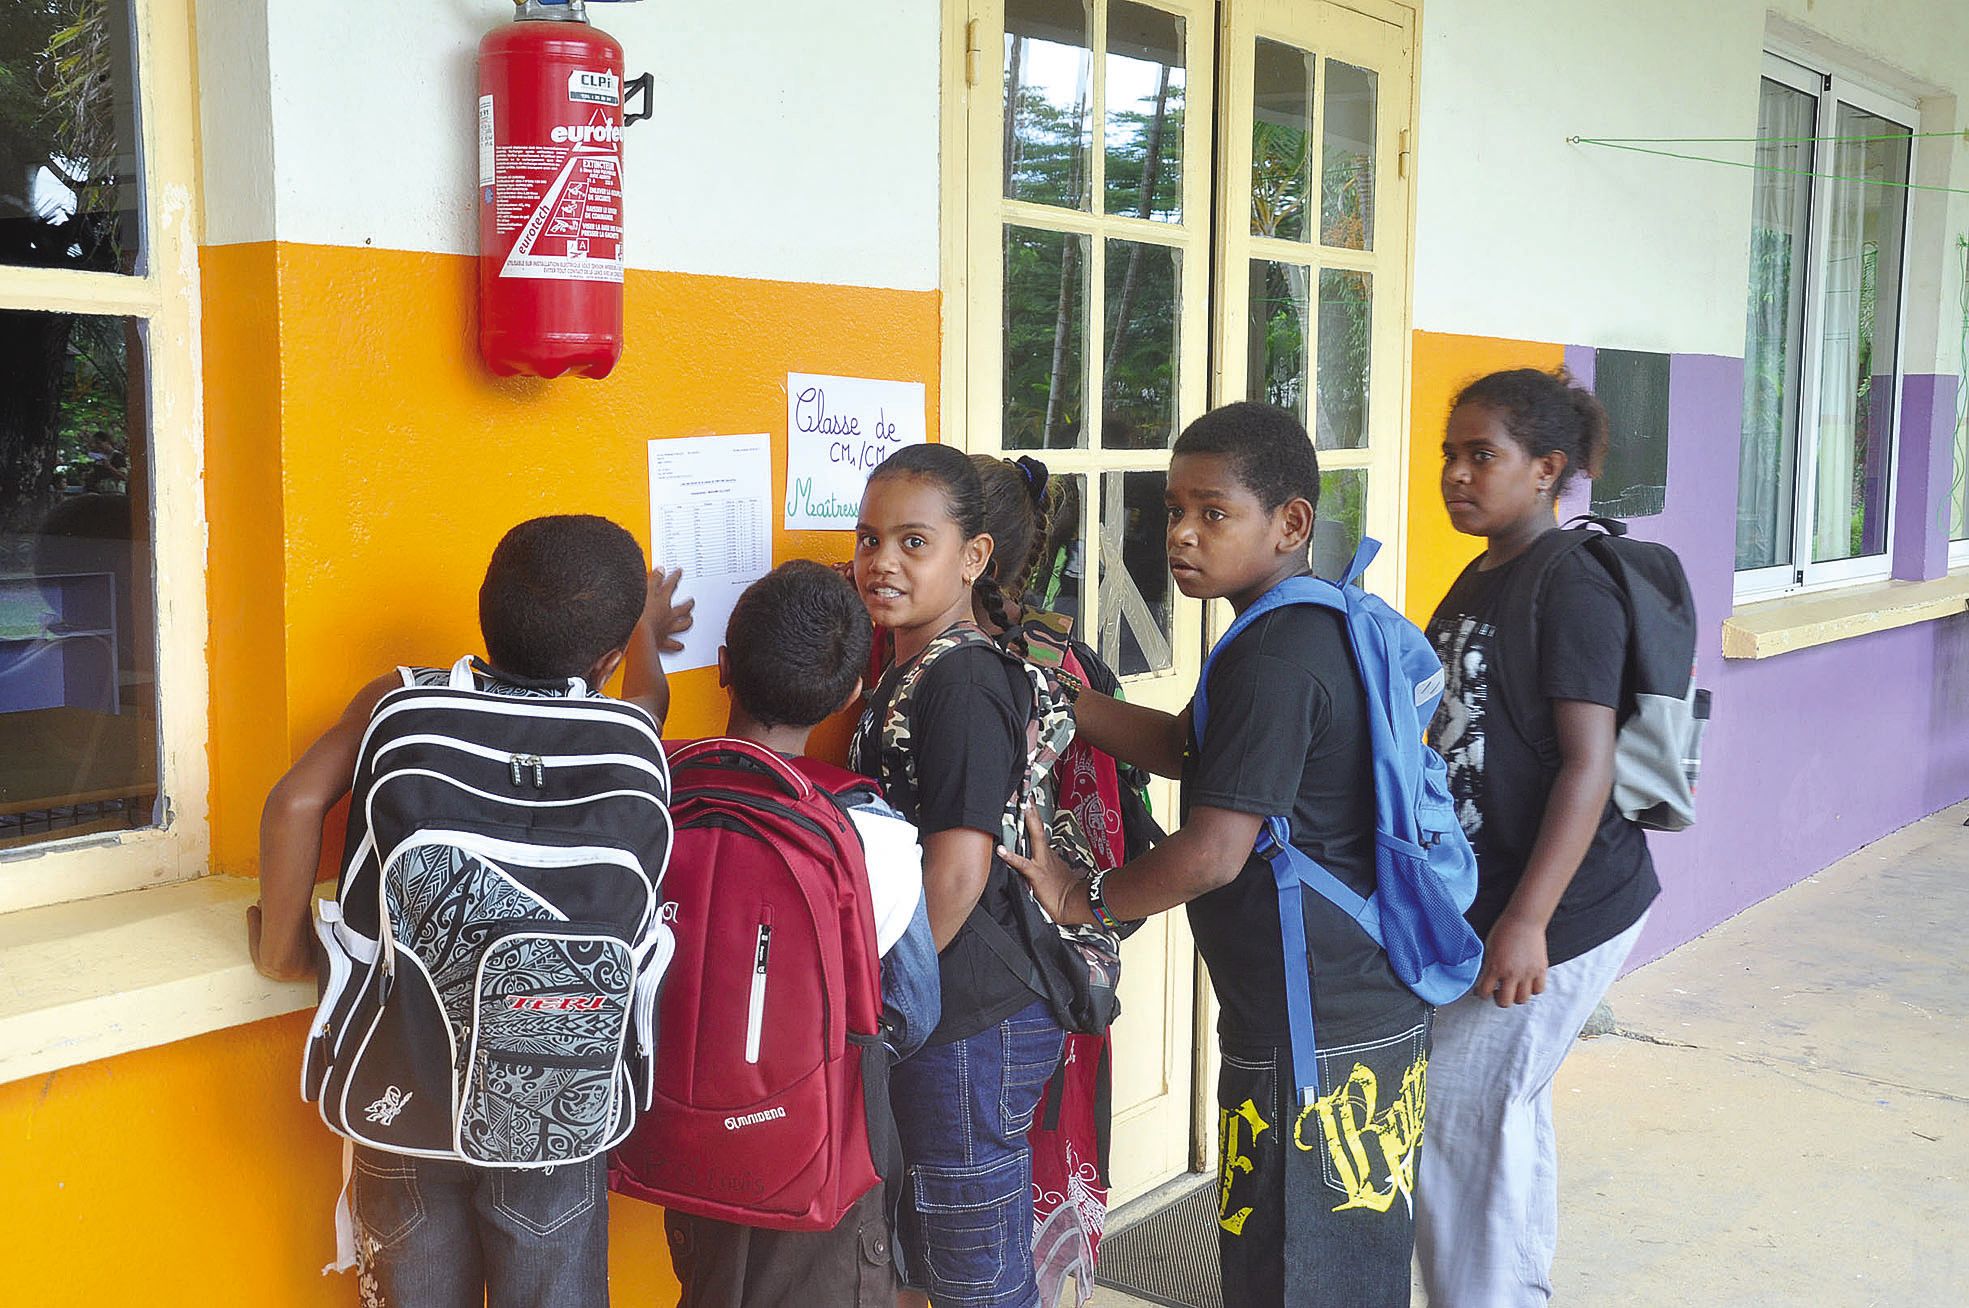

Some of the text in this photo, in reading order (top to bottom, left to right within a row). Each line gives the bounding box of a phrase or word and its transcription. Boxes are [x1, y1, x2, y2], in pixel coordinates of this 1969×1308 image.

[581, 74, 611, 88] CLPi
[519, 205, 550, 255] eurotech
[579, 241, 587, 250] A
[796, 387, 902, 442] Classe de
[830, 440, 886, 471] CM1/CM
[787, 477, 860, 518] Maîtress
